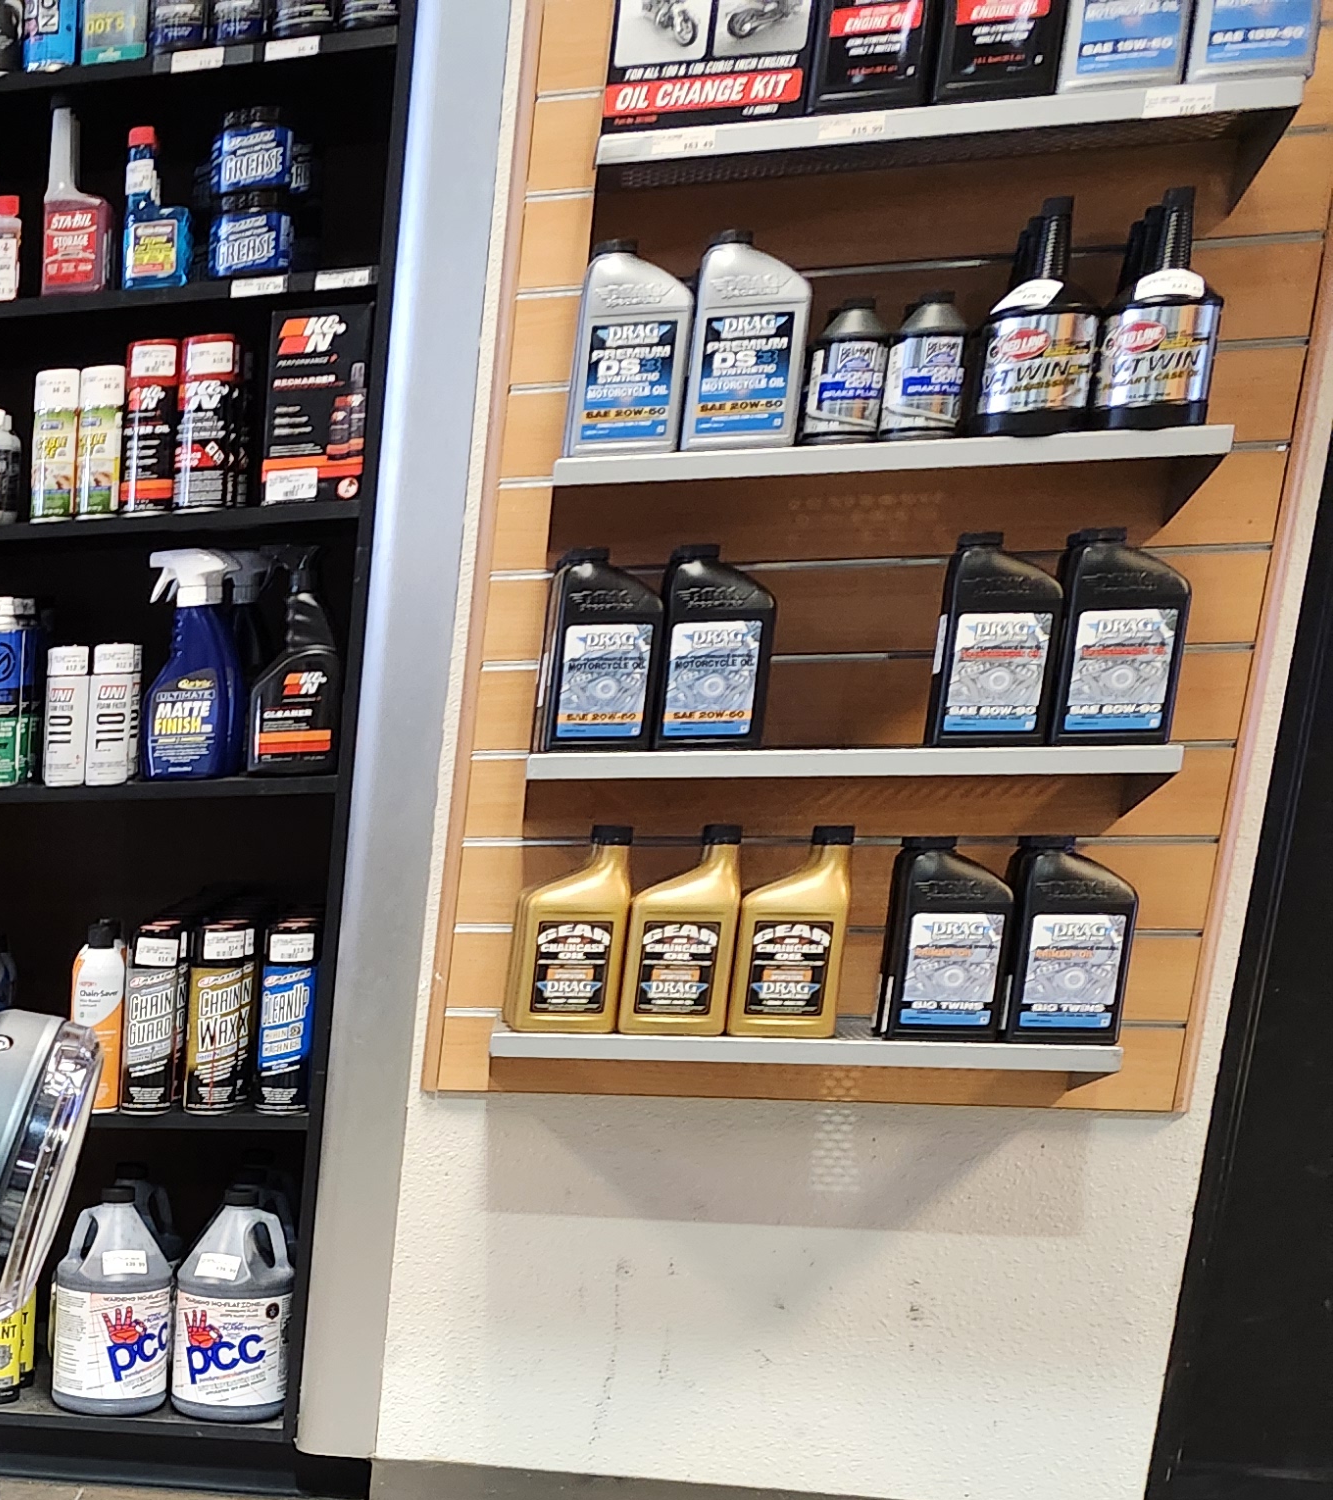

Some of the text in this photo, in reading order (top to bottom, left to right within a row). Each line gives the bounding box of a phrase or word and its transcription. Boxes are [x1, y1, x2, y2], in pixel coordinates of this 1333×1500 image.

[616, 73, 792, 111] OIL CHANGE KIT
[607, 323, 660, 342] DRAG
[724, 314, 777, 333] DRAG
[50, 688, 73, 702] UNI
[99, 685, 127, 700] UNI
[155, 700, 212, 719] MATTE
[154, 717, 202, 736] FINISH
[537, 924, 611, 945] GEAR
[642, 924, 719, 946] GEAR
[752, 924, 832, 946] GEAR
[185, 1333, 268, 1385] pcc
